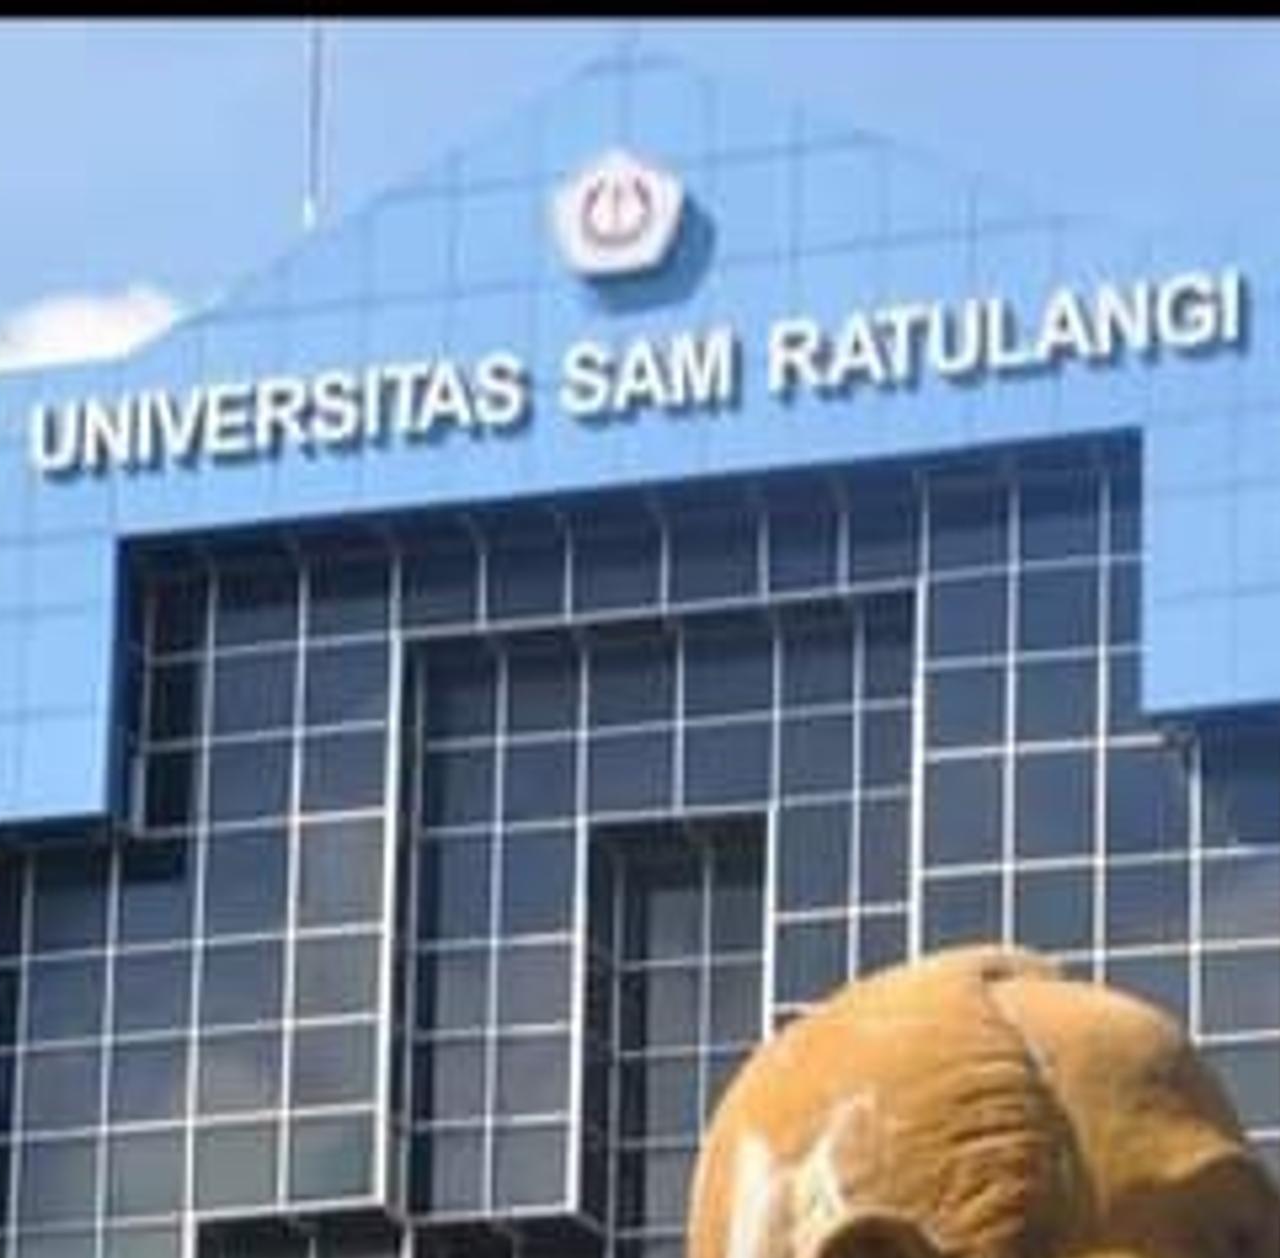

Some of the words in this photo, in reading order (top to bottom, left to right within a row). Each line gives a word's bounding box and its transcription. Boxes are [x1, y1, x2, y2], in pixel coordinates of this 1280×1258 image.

[31, 352, 526, 473] UNIVERSITAS
[559, 329, 735, 415] SAM
[766, 266, 1243, 393] RATULANGI
